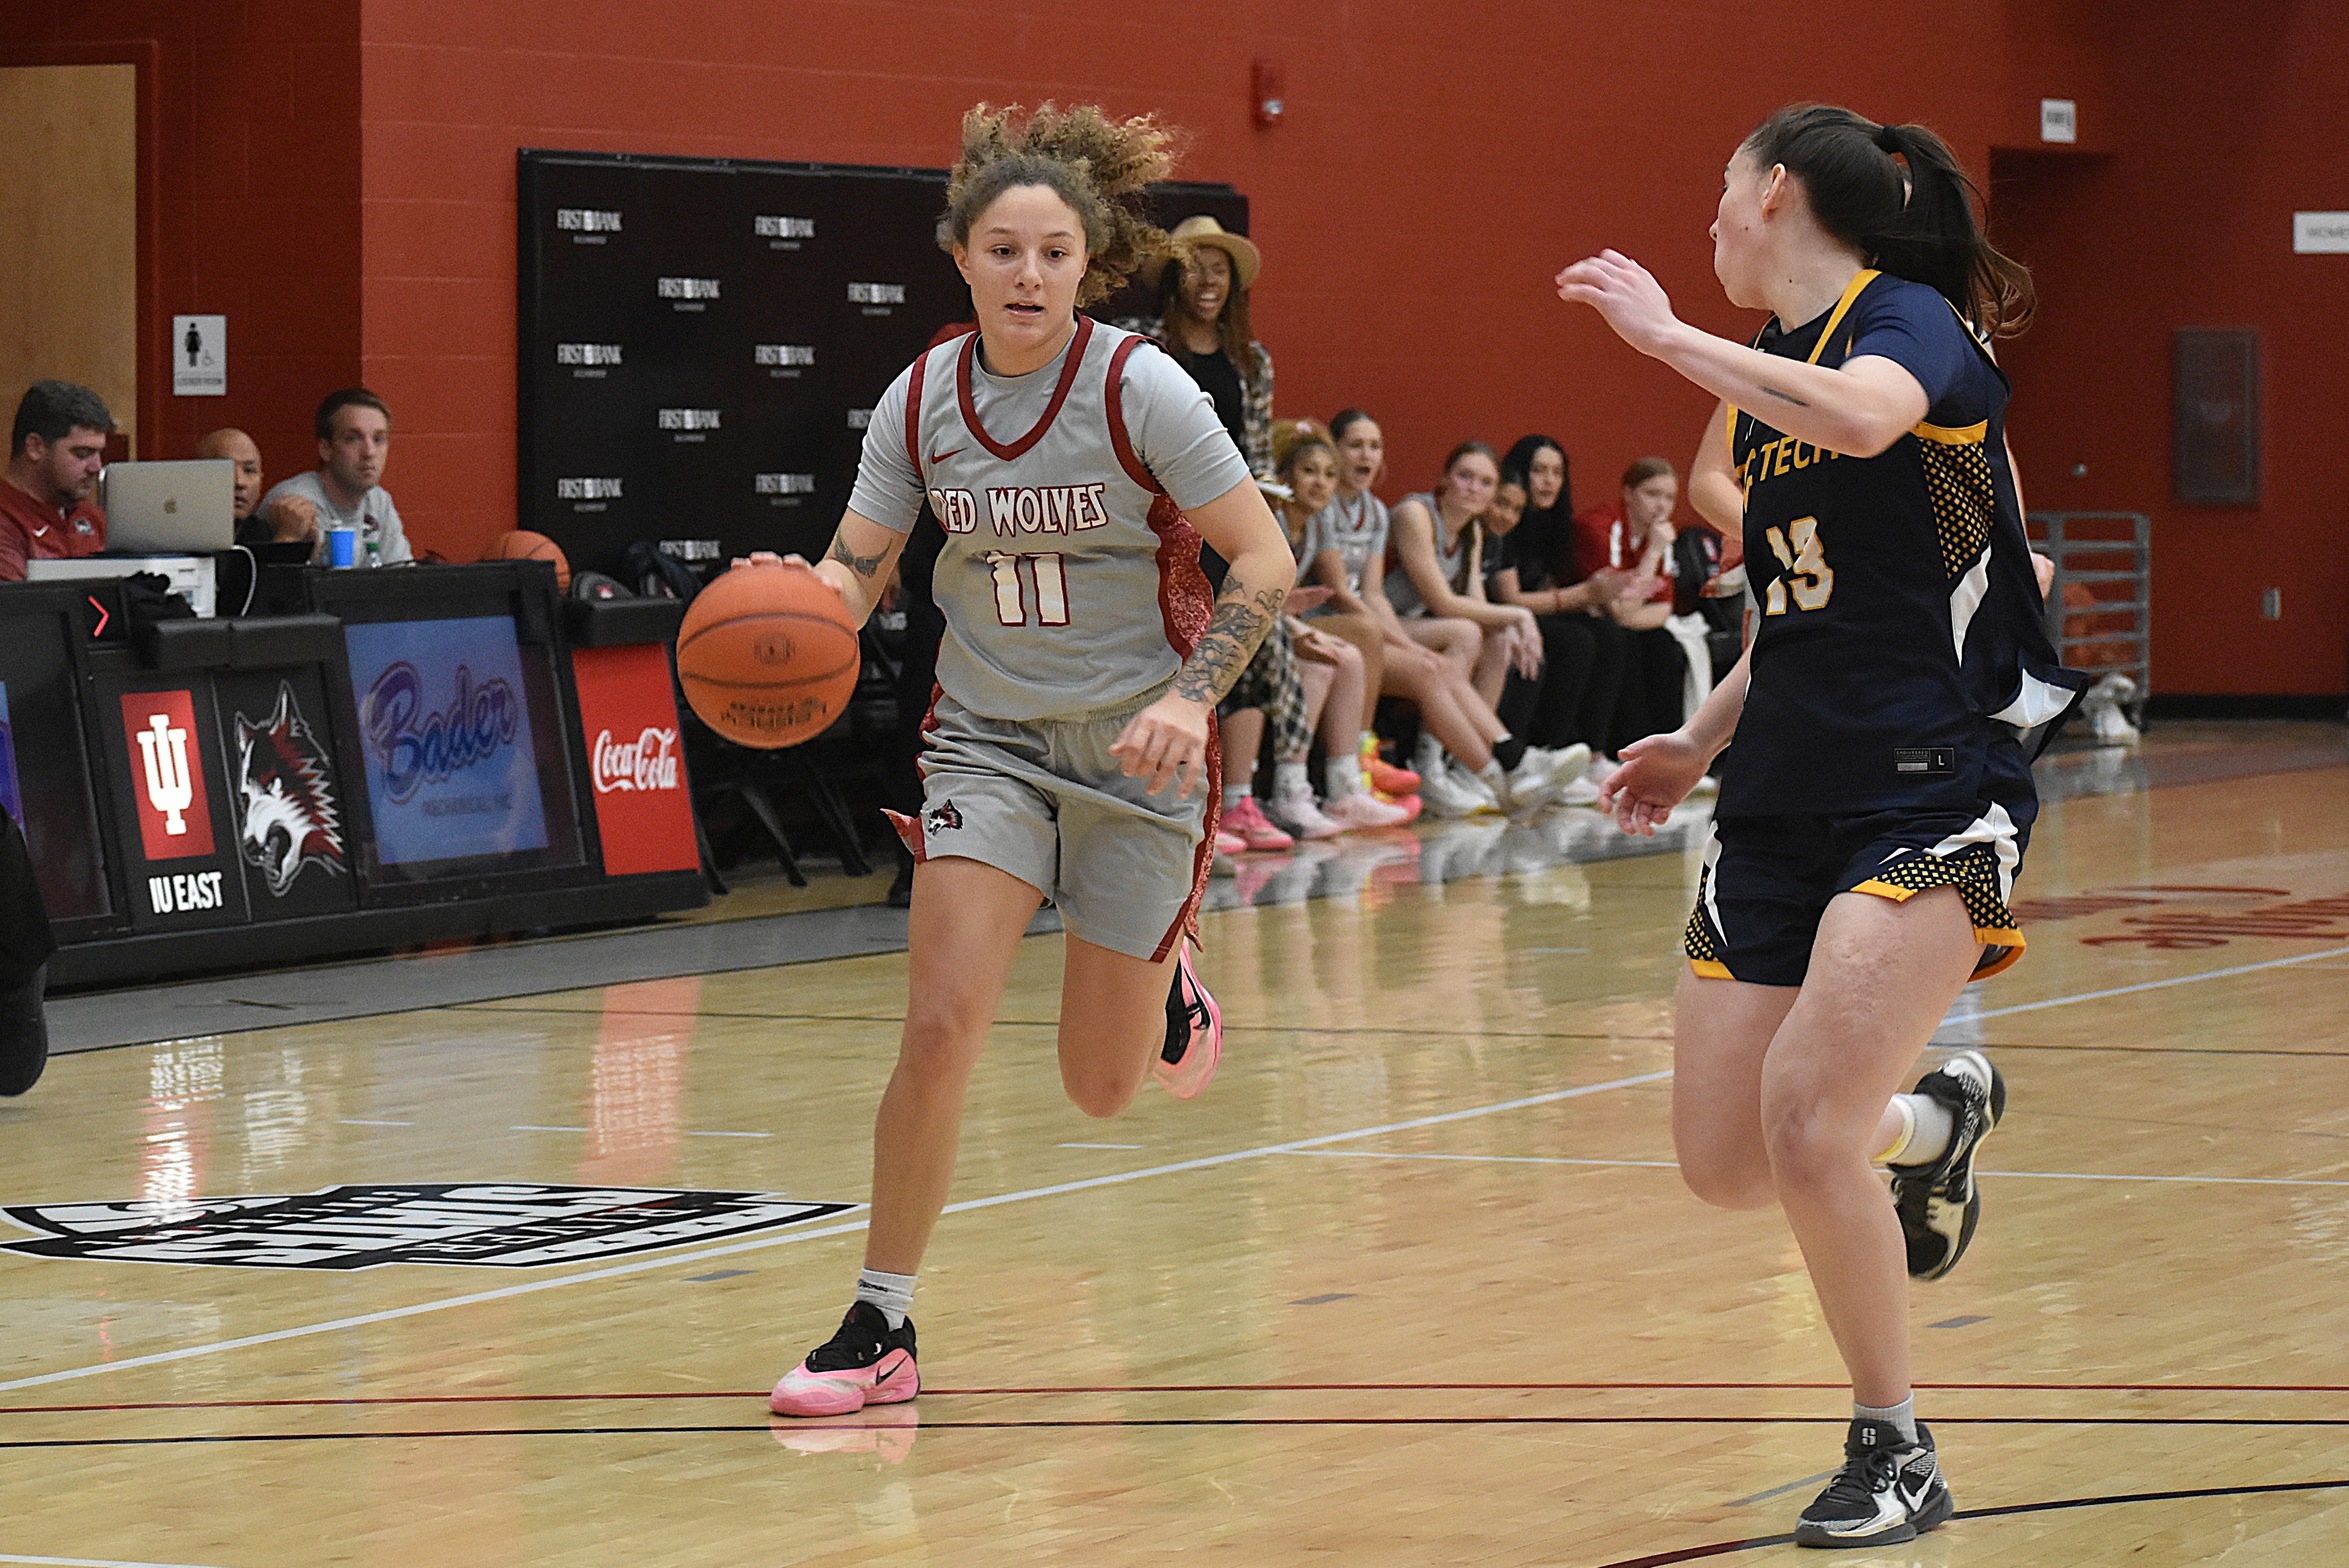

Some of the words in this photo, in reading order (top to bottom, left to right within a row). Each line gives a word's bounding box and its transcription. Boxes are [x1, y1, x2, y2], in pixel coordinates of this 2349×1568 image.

[986, 483, 1107, 537] WOLVES
[985, 550, 1071, 627] 11
[1938, 754, 1945, 766] L
[149, 876, 174, 914] IU
[172, 871, 223, 911] EAST
[82, 1186, 687, 1264] STATES
[391, 1207, 702, 1252] RIVER
